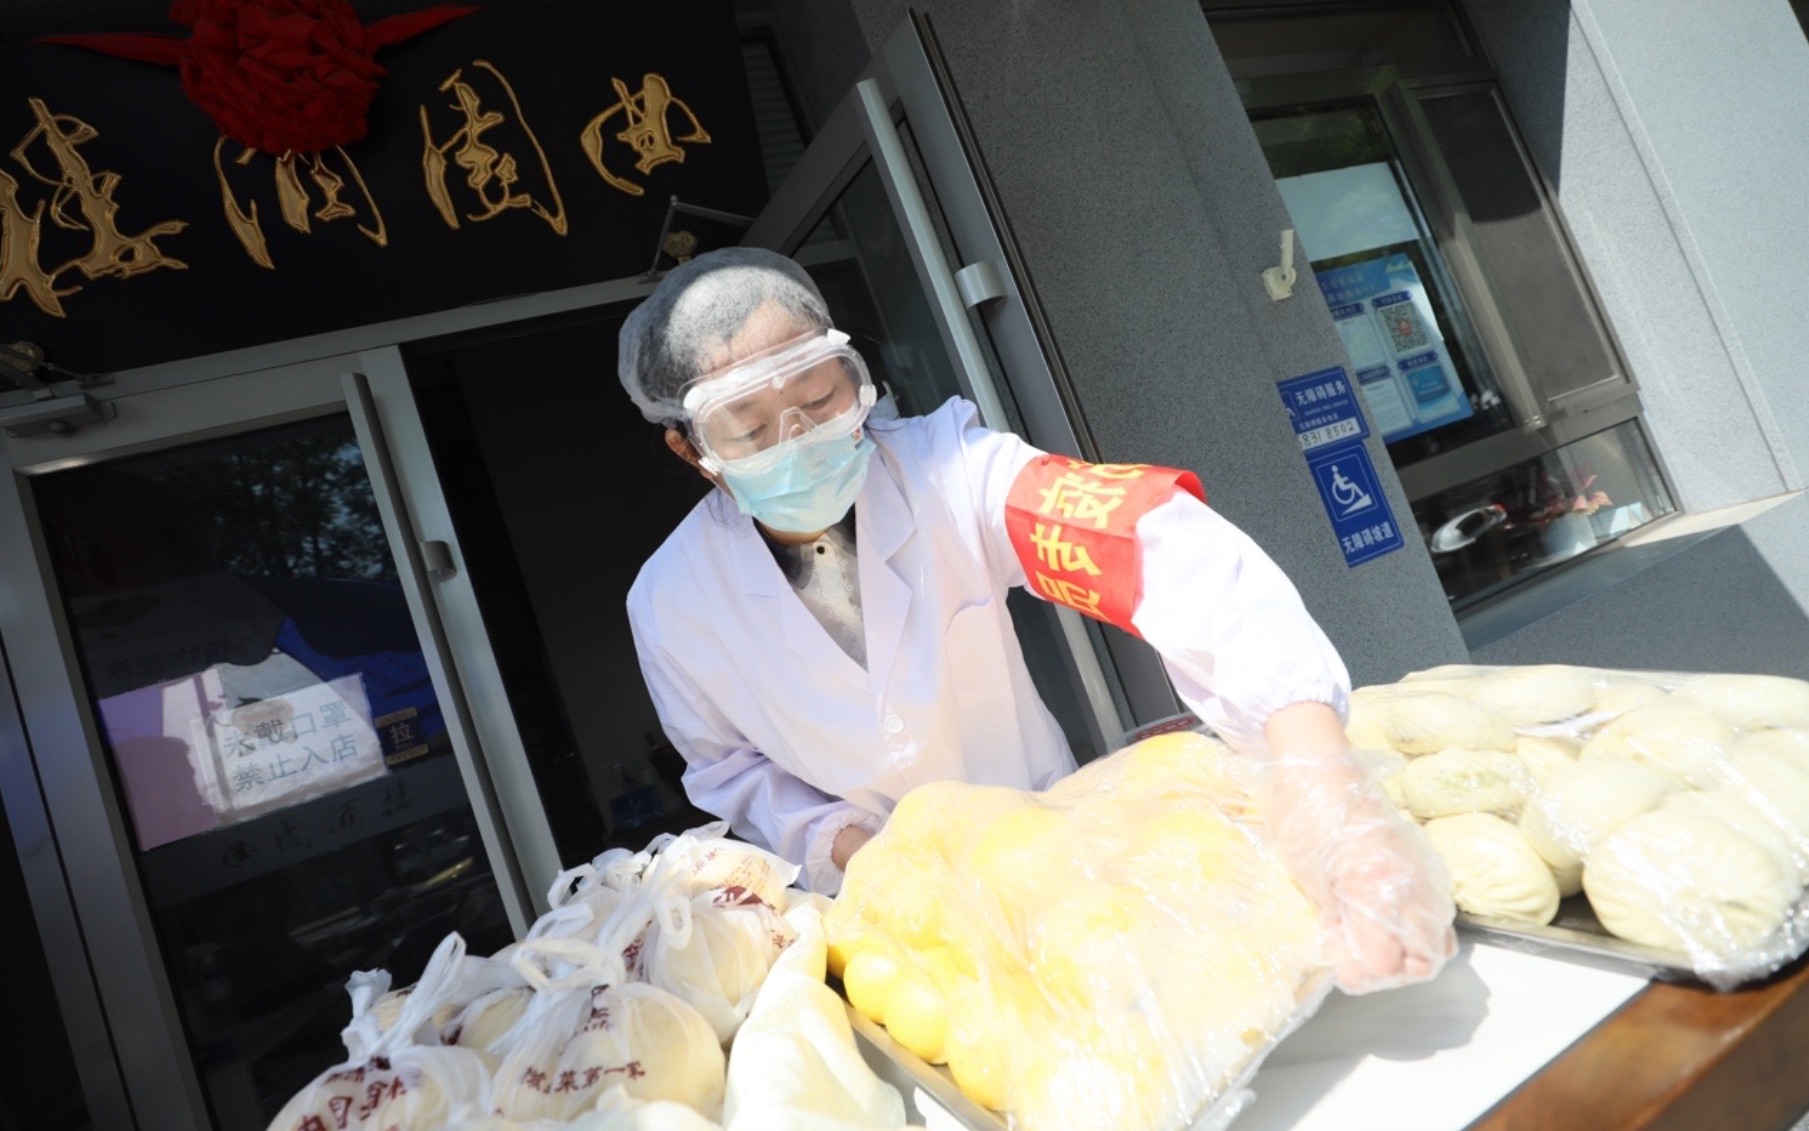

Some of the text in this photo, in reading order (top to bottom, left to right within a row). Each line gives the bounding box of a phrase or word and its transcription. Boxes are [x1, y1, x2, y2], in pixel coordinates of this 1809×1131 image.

[1295, 380, 1347, 406] 无障碍服务
[1341, 521, 1395, 554] 无障碍坡道
[224, 700, 351, 758] 未戴口罩
[389, 719, 414, 744] 拉
[232, 732, 359, 793] 禁止入店
